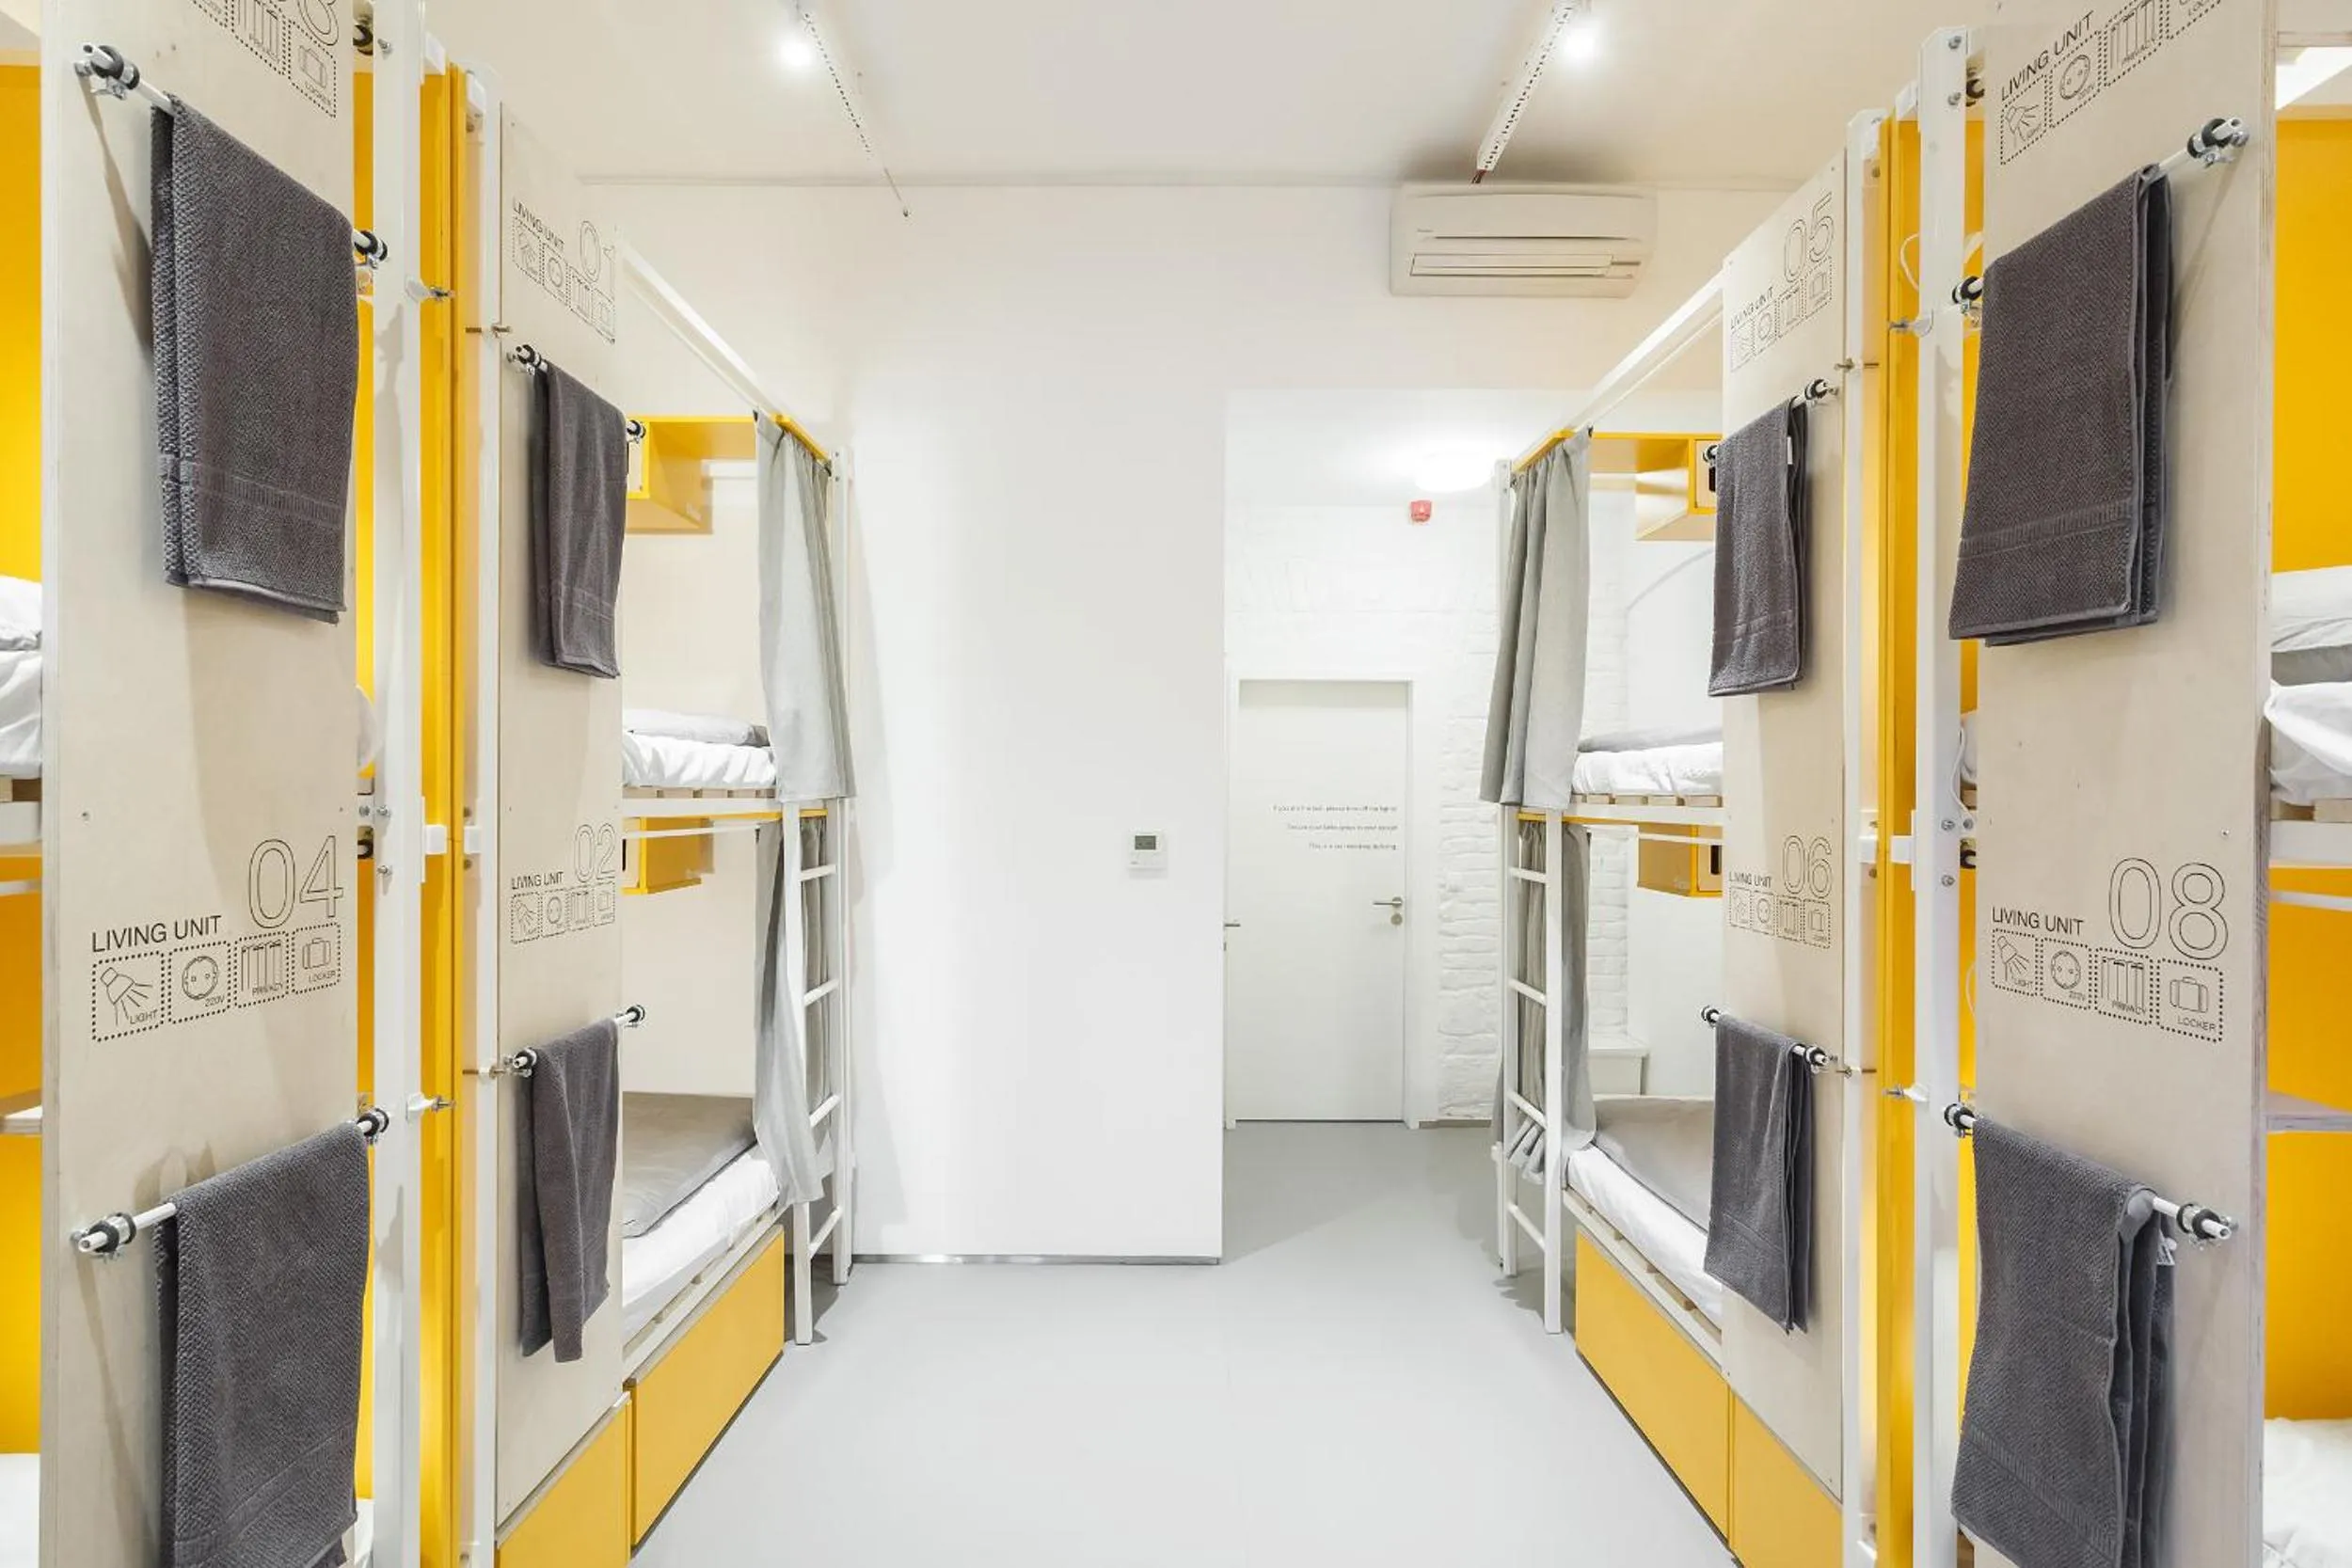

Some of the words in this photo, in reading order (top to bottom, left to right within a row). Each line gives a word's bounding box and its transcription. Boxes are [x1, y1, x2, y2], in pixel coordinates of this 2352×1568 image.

[2001, 51, 2049, 102] LIVING
[2054, 10, 2094, 56] UNIT
[1784, 191, 1834, 283] 05
[248, 834, 344, 929] 04
[574, 823, 615, 883] 02
[1783, 835, 1832, 899] 06
[92, 922, 167, 953] LIVING
[174, 914, 222, 940] UNIT
[1992, 906, 2040, 928] LIVING
[2044, 915, 2085, 936] UNIT
[2108, 857, 2229, 960] 08
[129, 1008, 159, 1025] LIGHT
[2176, 1014, 2217, 1032] LOCKER
